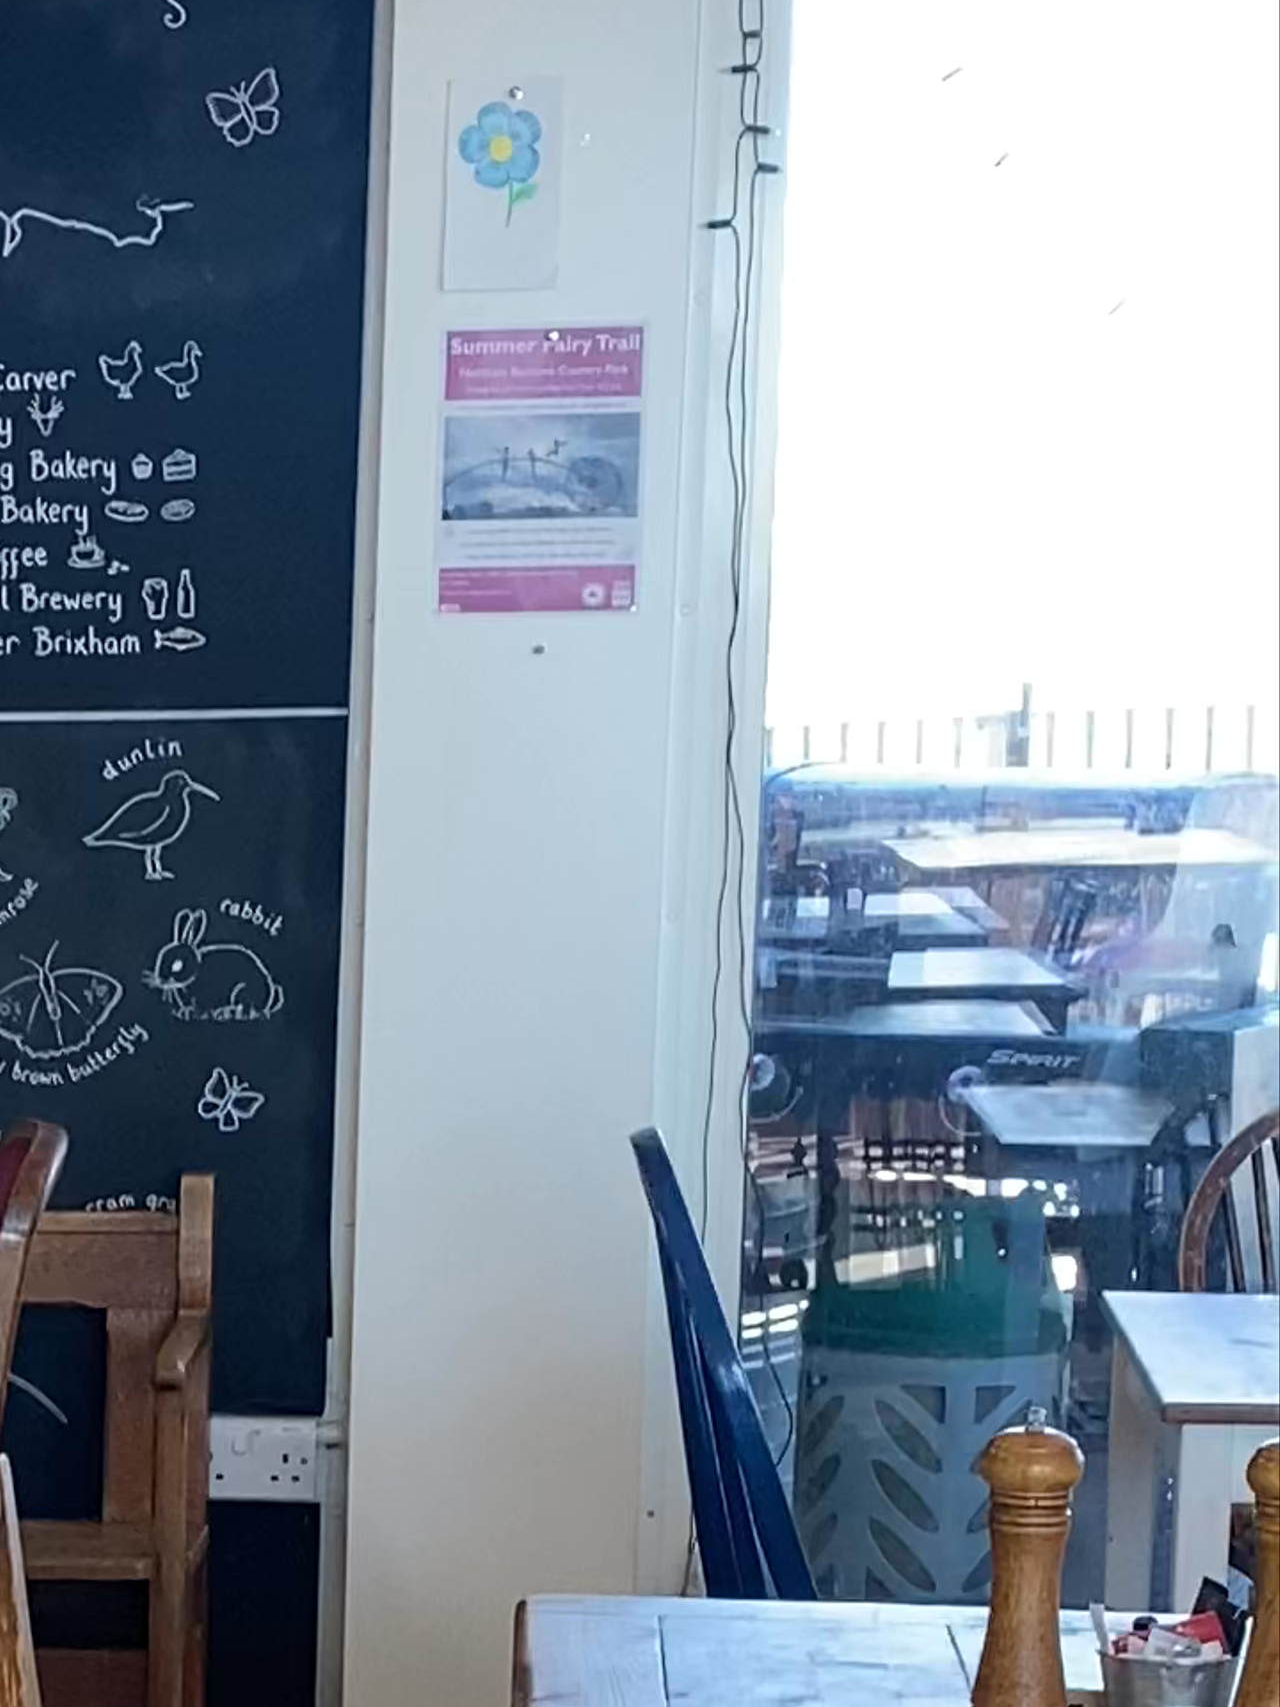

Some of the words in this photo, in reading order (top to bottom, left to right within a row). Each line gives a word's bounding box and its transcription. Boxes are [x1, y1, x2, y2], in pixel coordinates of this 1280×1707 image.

[450, 337, 539, 356] Summer
[595, 333, 641, 351] Trail
[29, 448, 117, 496] Bakery
[0, 494, 89, 541] Bakery
[19, 582, 122, 624] Brewery
[32, 625, 141, 657] Brixham
[101, 739, 184, 783] dunlin
[219, 898, 285, 937] rabbit
[11, 1061, 64, 1086] brown
[67, 1022, 149, 1083] butterfly
